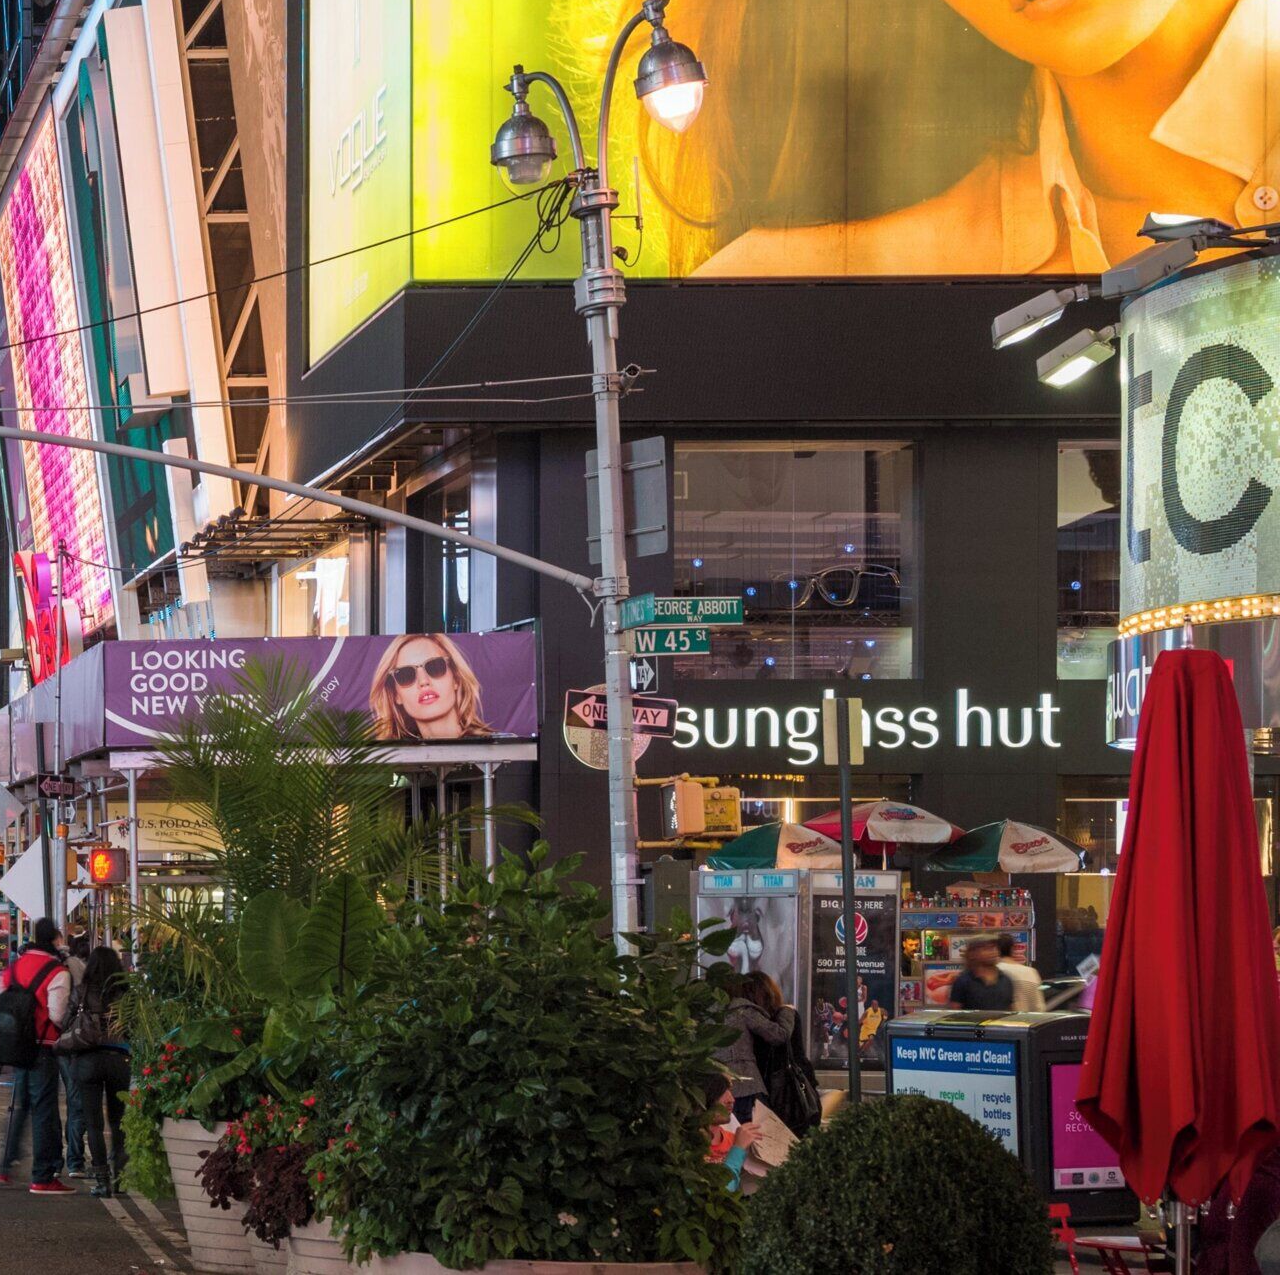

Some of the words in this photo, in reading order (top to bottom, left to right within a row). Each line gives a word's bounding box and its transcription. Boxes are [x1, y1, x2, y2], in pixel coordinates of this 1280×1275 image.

[653, 601, 693, 616] GEORGE
[697, 600, 739, 614] ABBOTT
[686, 615, 704, 623] WAY
[638, 631, 657, 652] W
[664, 631, 691, 652] 45
[696, 629, 707, 642] St
[130, 648, 247, 672] LOOKING
[130, 672, 209, 693] GOOD
[131, 694, 186, 717] NEW
[582, 701, 609, 721] ONE
[672, 689, 939, 766] sungss
[955, 687, 1062, 749] hut
[137, 819, 156, 829] U.S.
[159, 819, 189, 829] POLO
[713, 875, 734, 888] TITAN
[762, 874, 785, 888] TITAN
[820, 900, 839, 909] BIG
[864, 901, 883, 910] HERE
[817, 959, 833, 967] 590
[897, 1046, 917, 1062] Keep
[919, 1048, 936, 1061] NYC
[938, 1049, 963, 1062] Green
[965, 1050, 981, 1063] and
[983, 1050, 1011, 1064] Clean!
[939, 1089, 965, 1102] recycle
[982, 1092, 1011, 1104] recycle
[983, 1107, 1011, 1120] bottles
[992, 1127, 1011, 1138] cans
